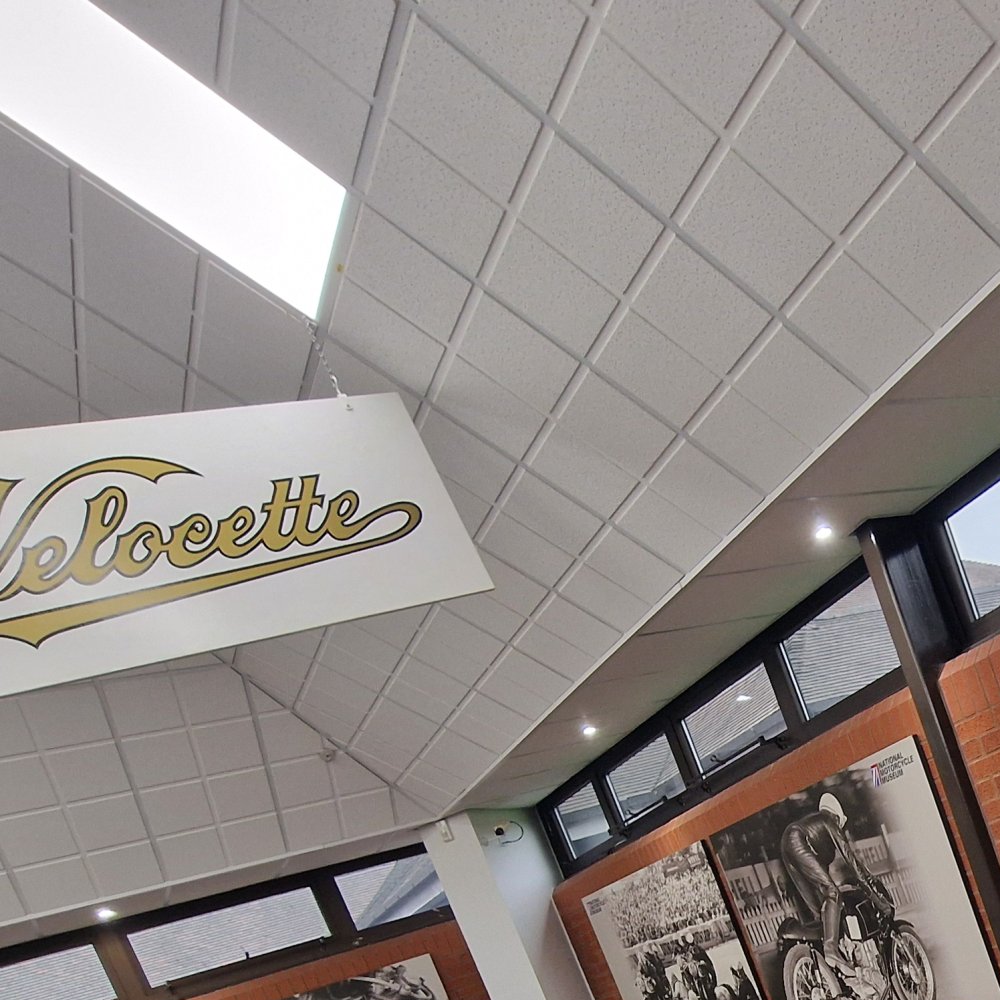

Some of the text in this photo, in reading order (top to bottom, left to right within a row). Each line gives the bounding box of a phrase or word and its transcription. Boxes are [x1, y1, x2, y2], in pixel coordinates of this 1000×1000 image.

[0, 455, 422, 608] Velocette
[878, 752, 904, 768] NATIONAL
[880, 755, 914, 776] MOTORCYCLE
[880, 769, 904, 785] MUSEUM
